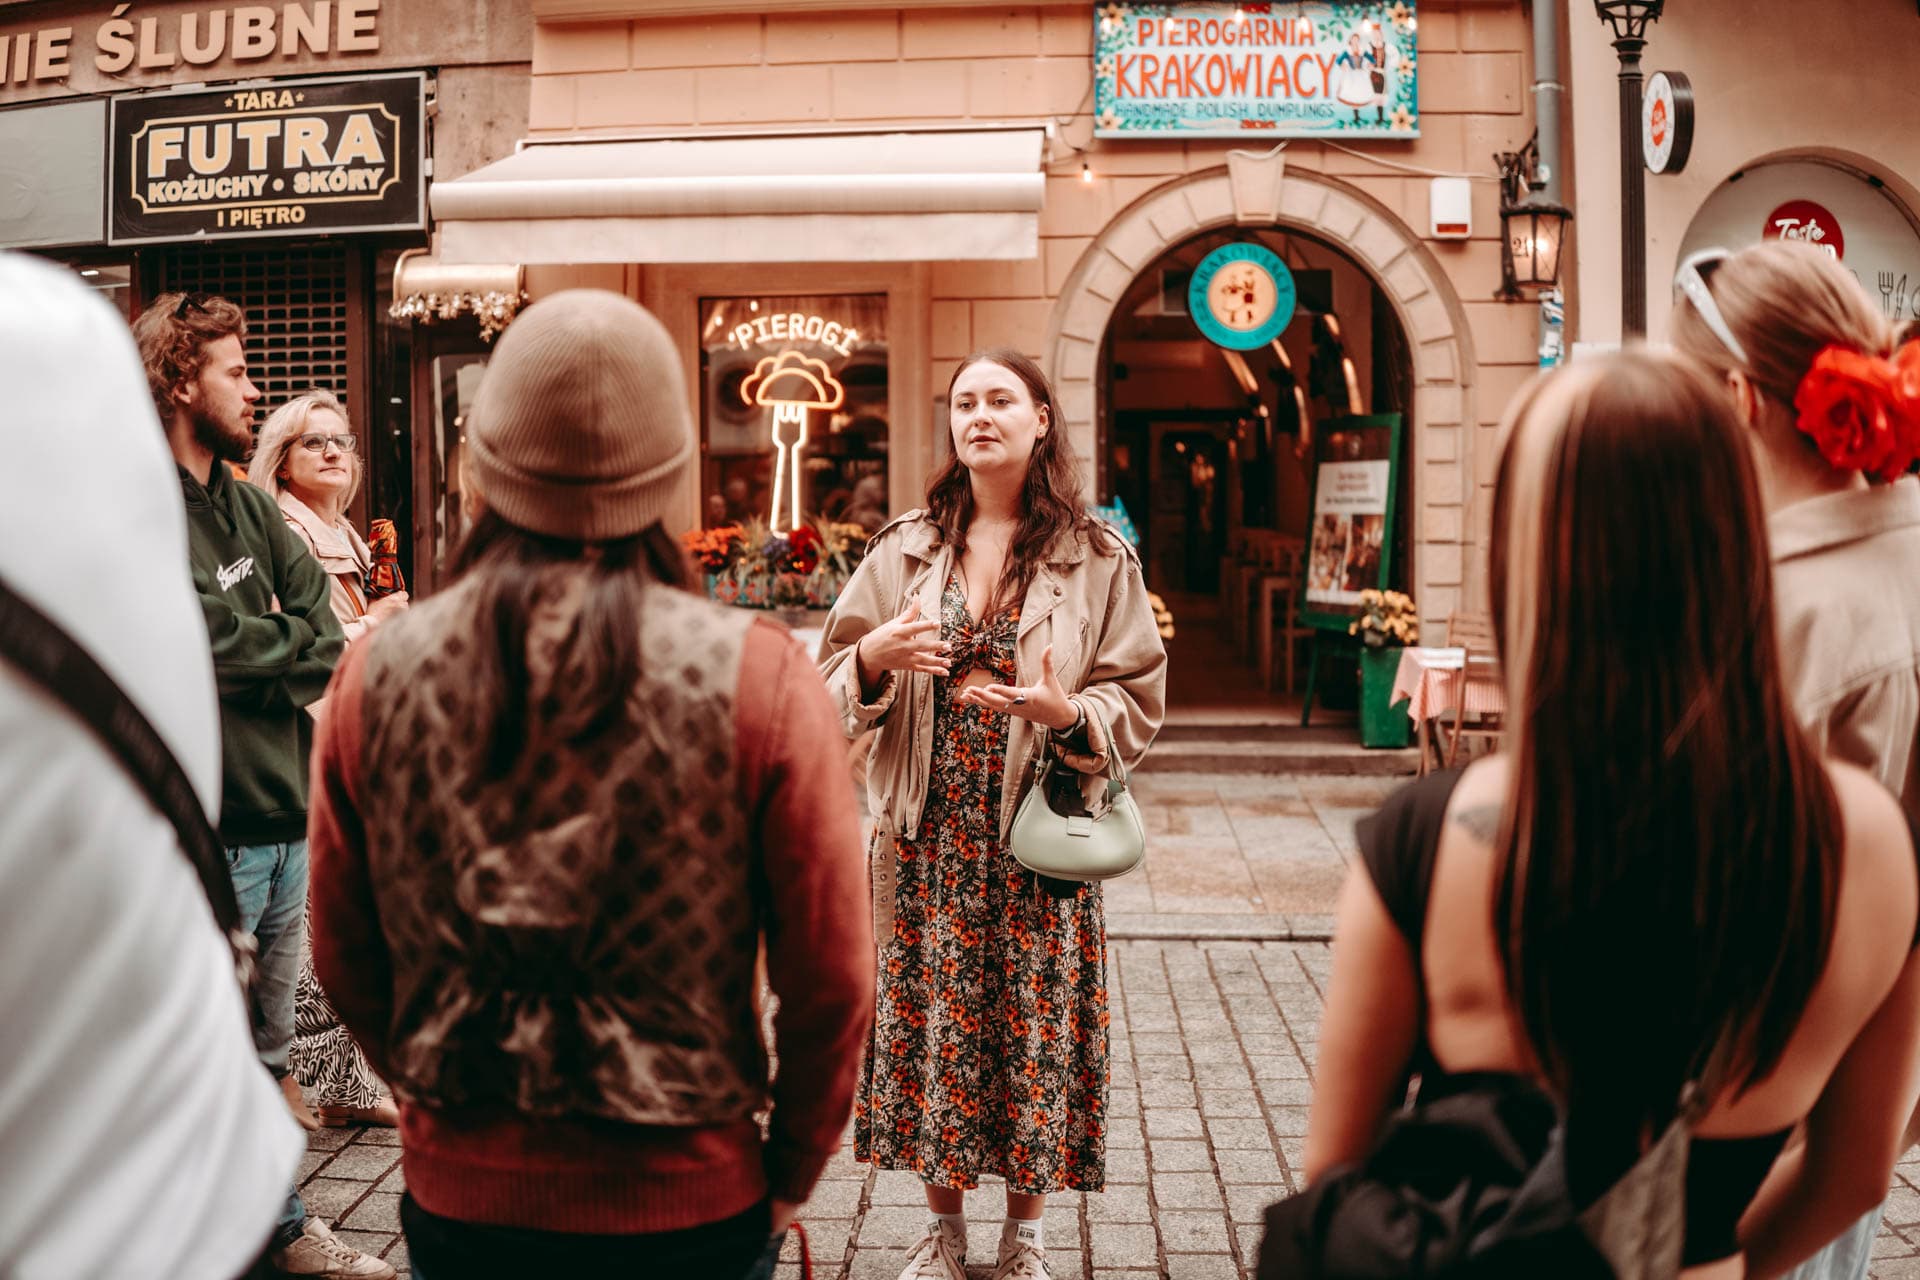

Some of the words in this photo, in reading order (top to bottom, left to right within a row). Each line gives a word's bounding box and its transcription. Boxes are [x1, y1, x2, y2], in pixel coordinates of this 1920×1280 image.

[0, 27, 72, 84] IE
[95, 0, 380, 73] ŚLUBNE
[1137, 17, 1315, 47] PIEROGARNIA
[1115, 53, 1337, 98] KRAKOWIACY
[234, 90, 295, 111] TARA
[1114, 102, 1187, 118] HANDMADE
[1196, 102, 1249, 117] POLISH
[1257, 102, 1335, 118] DUMPLINGS
[147, 113, 386, 178] FUTRA
[147, 173, 269, 204] KOŻUCHY
[293, 166, 385, 194] SKÓRY
[229, 205, 306, 230] PIĘTRO
[1775, 218, 1826, 241] Taste
[735, 313, 860, 357] PIEROGI
